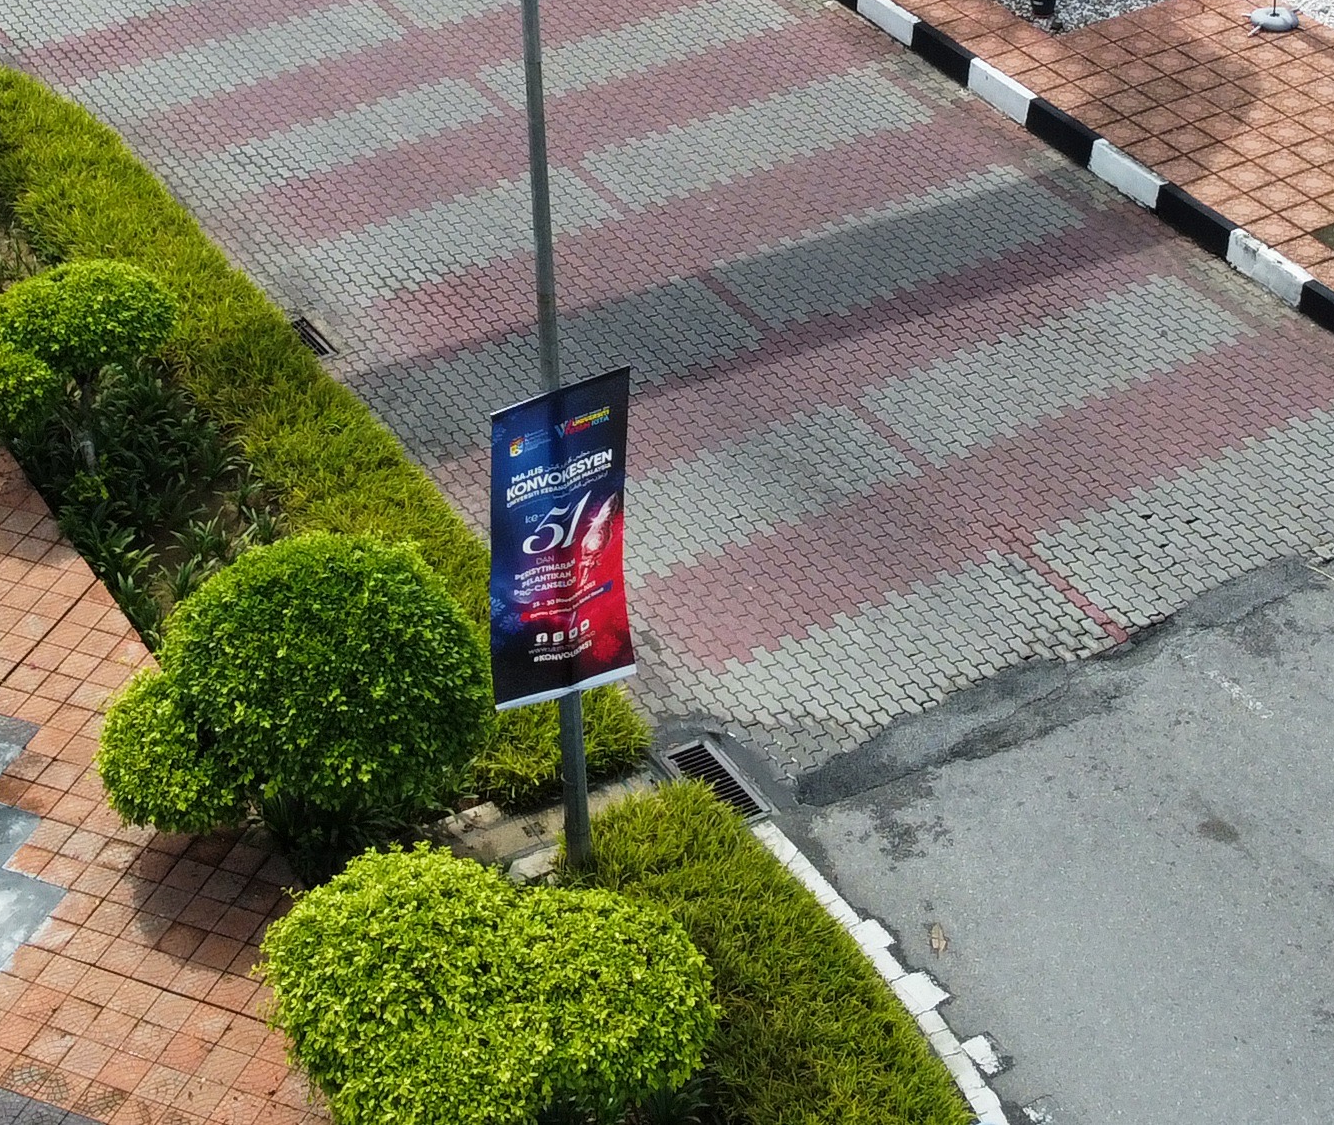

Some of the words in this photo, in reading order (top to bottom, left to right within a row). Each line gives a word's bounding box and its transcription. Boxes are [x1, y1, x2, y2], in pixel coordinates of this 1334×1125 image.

[506, 448, 613, 502] KONVOKESYEN
[511, 465, 544, 484] MAJLIS
[522, 490, 592, 555] 51
[514, 557, 576, 582] PERISYTIHARAN
[535, 555, 555, 565] DAN
[521, 571, 572, 589] PELANTIKAN
